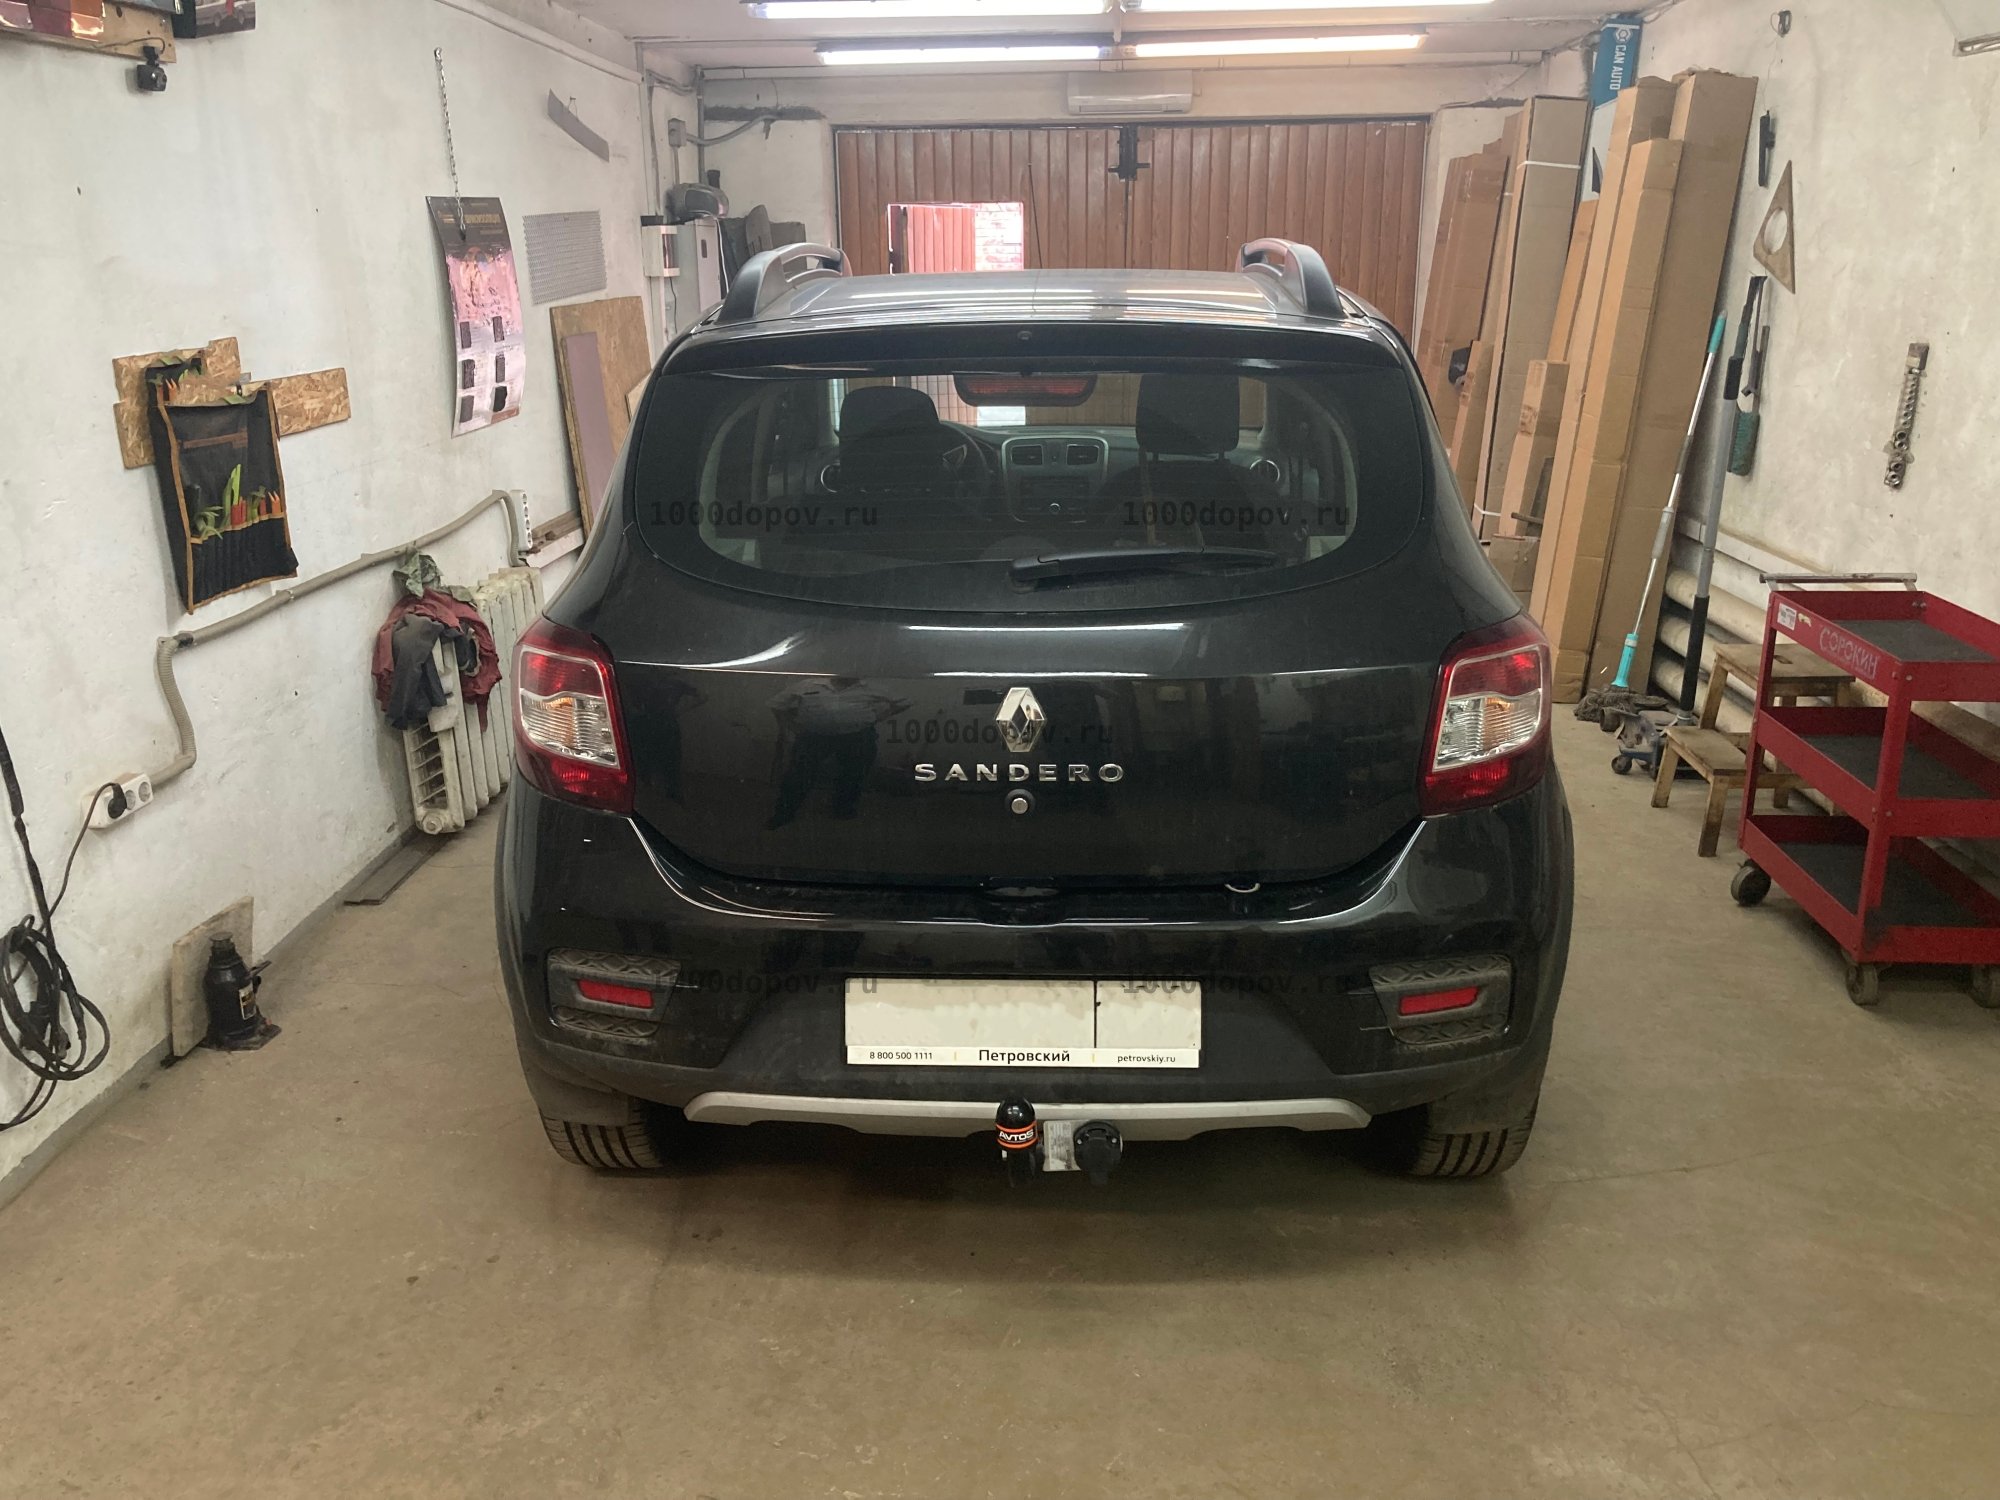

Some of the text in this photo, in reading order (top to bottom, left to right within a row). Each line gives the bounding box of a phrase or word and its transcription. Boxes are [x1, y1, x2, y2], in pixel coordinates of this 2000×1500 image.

[1609, 44, 1627, 90] CAN AUTO
[1819, 626, 1880, 680] СОРОКИН
[914, 763, 1124, 783] SANDERO
[869, 1051, 933, 1060] 8 800 500 1111
[979, 1049, 1070, 1065] Петровский
[1117, 1054, 1176, 1065] petrovskiy.ru
[999, 1128, 1034, 1142] AVTOS
